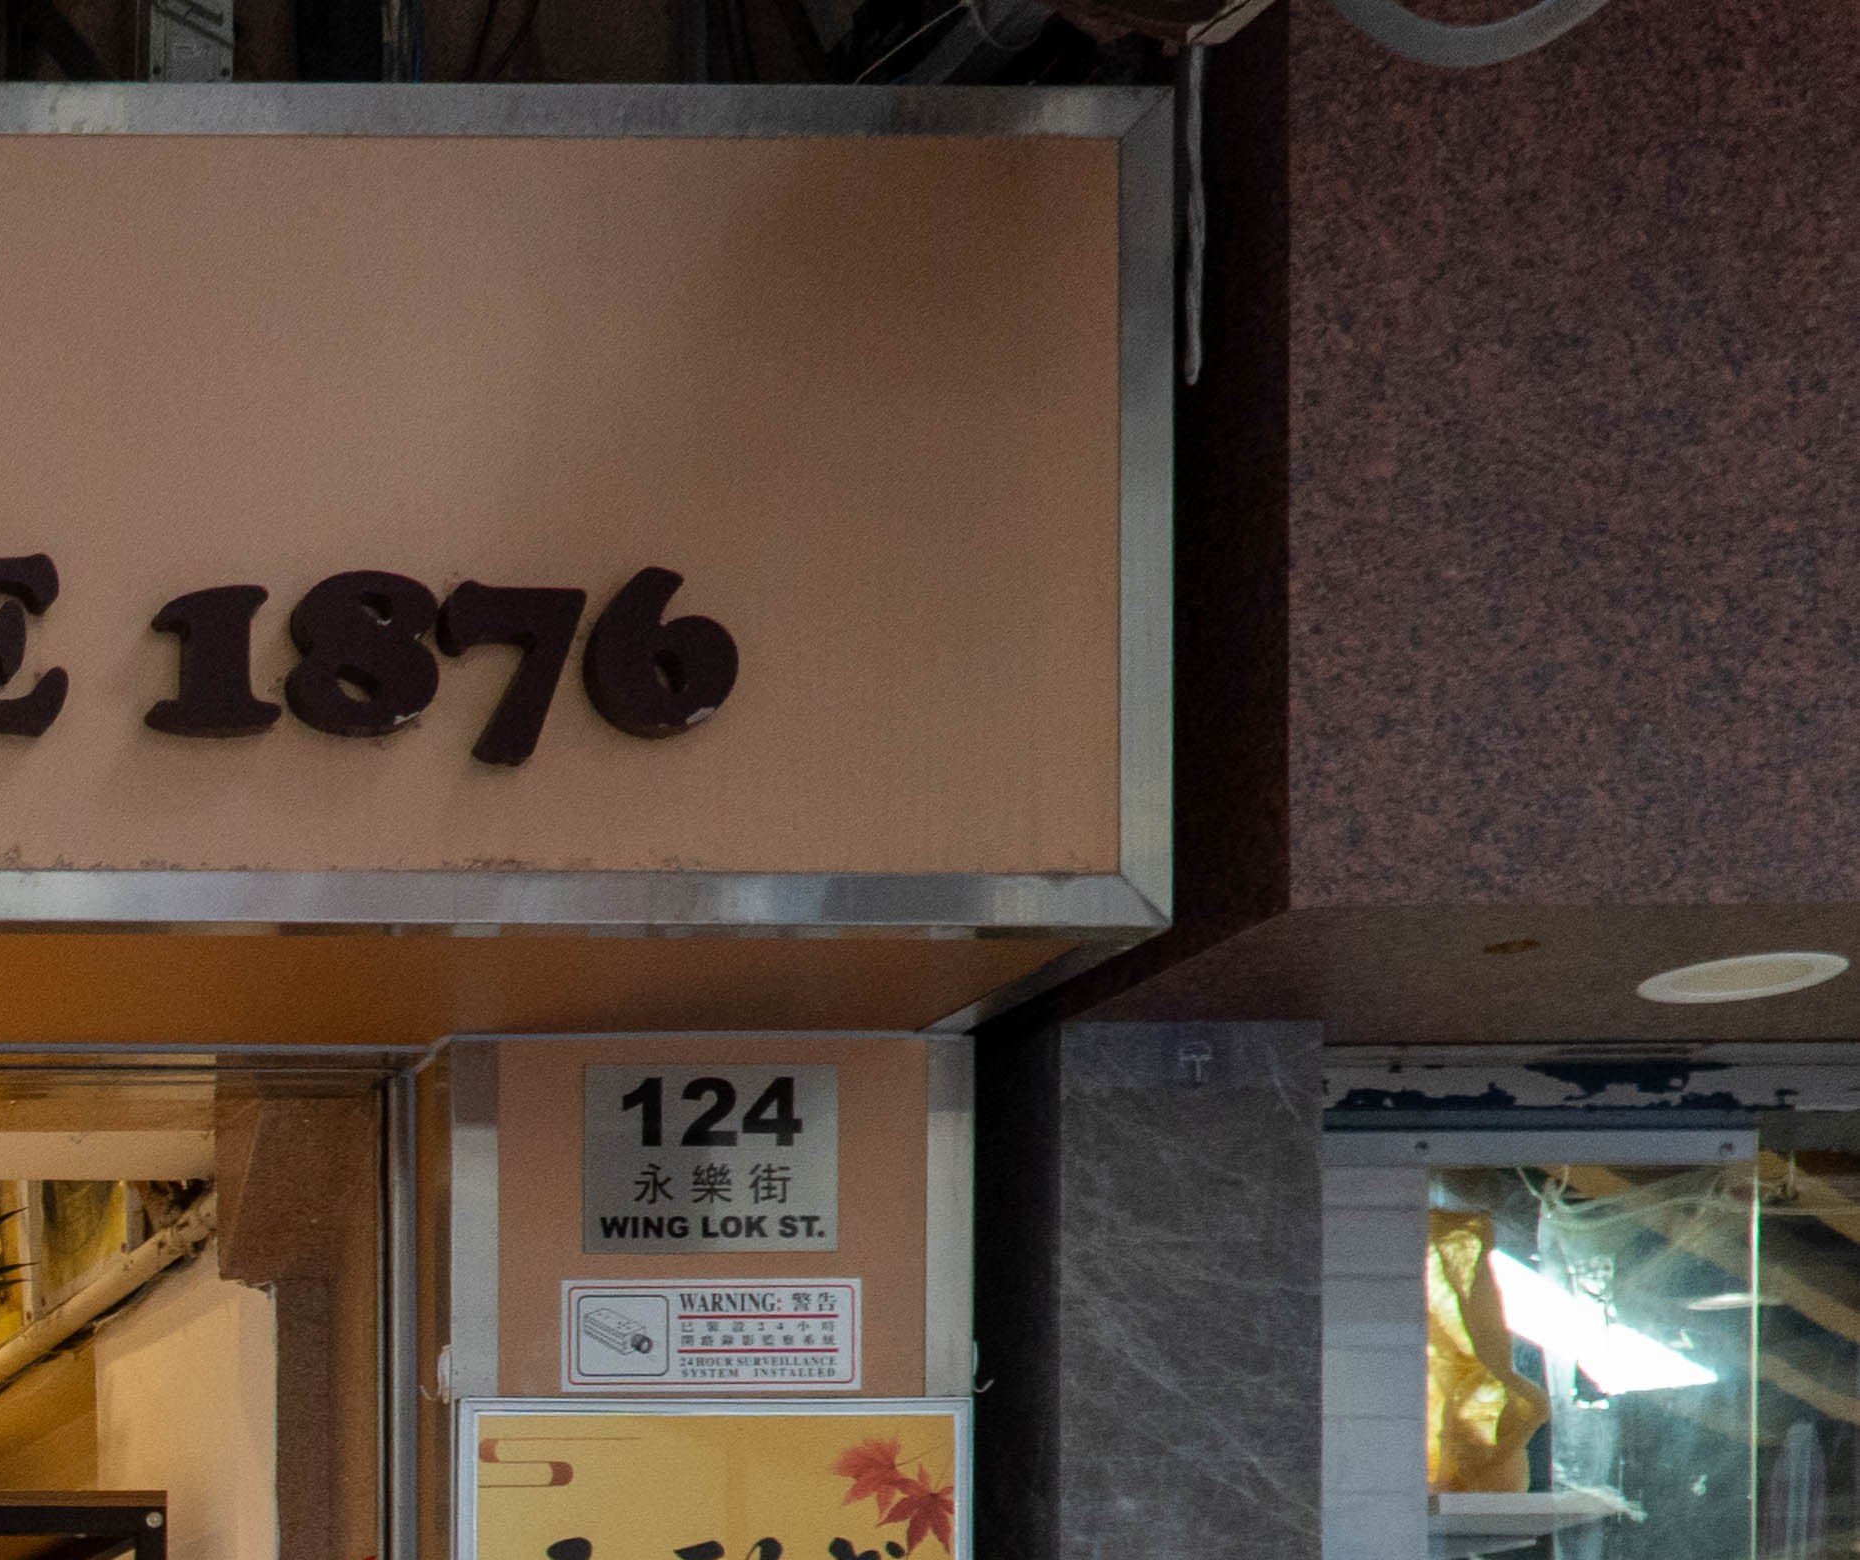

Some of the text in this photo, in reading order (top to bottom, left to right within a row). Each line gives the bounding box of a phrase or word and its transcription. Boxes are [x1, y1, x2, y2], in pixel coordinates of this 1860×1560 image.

[144, 566, 740, 767] 1876
[621, 1076, 804, 1148] 124
[634, 1163, 792, 1205] 永樂街
[599, 1214, 826, 1240] WING LOK ST.
[679, 1291, 838, 1313] WARNING: 警告
[681, 1367, 836, 1378] SYSTEM INSTALLED
[736, 1356, 838, 1367] SURVEILLANCE
